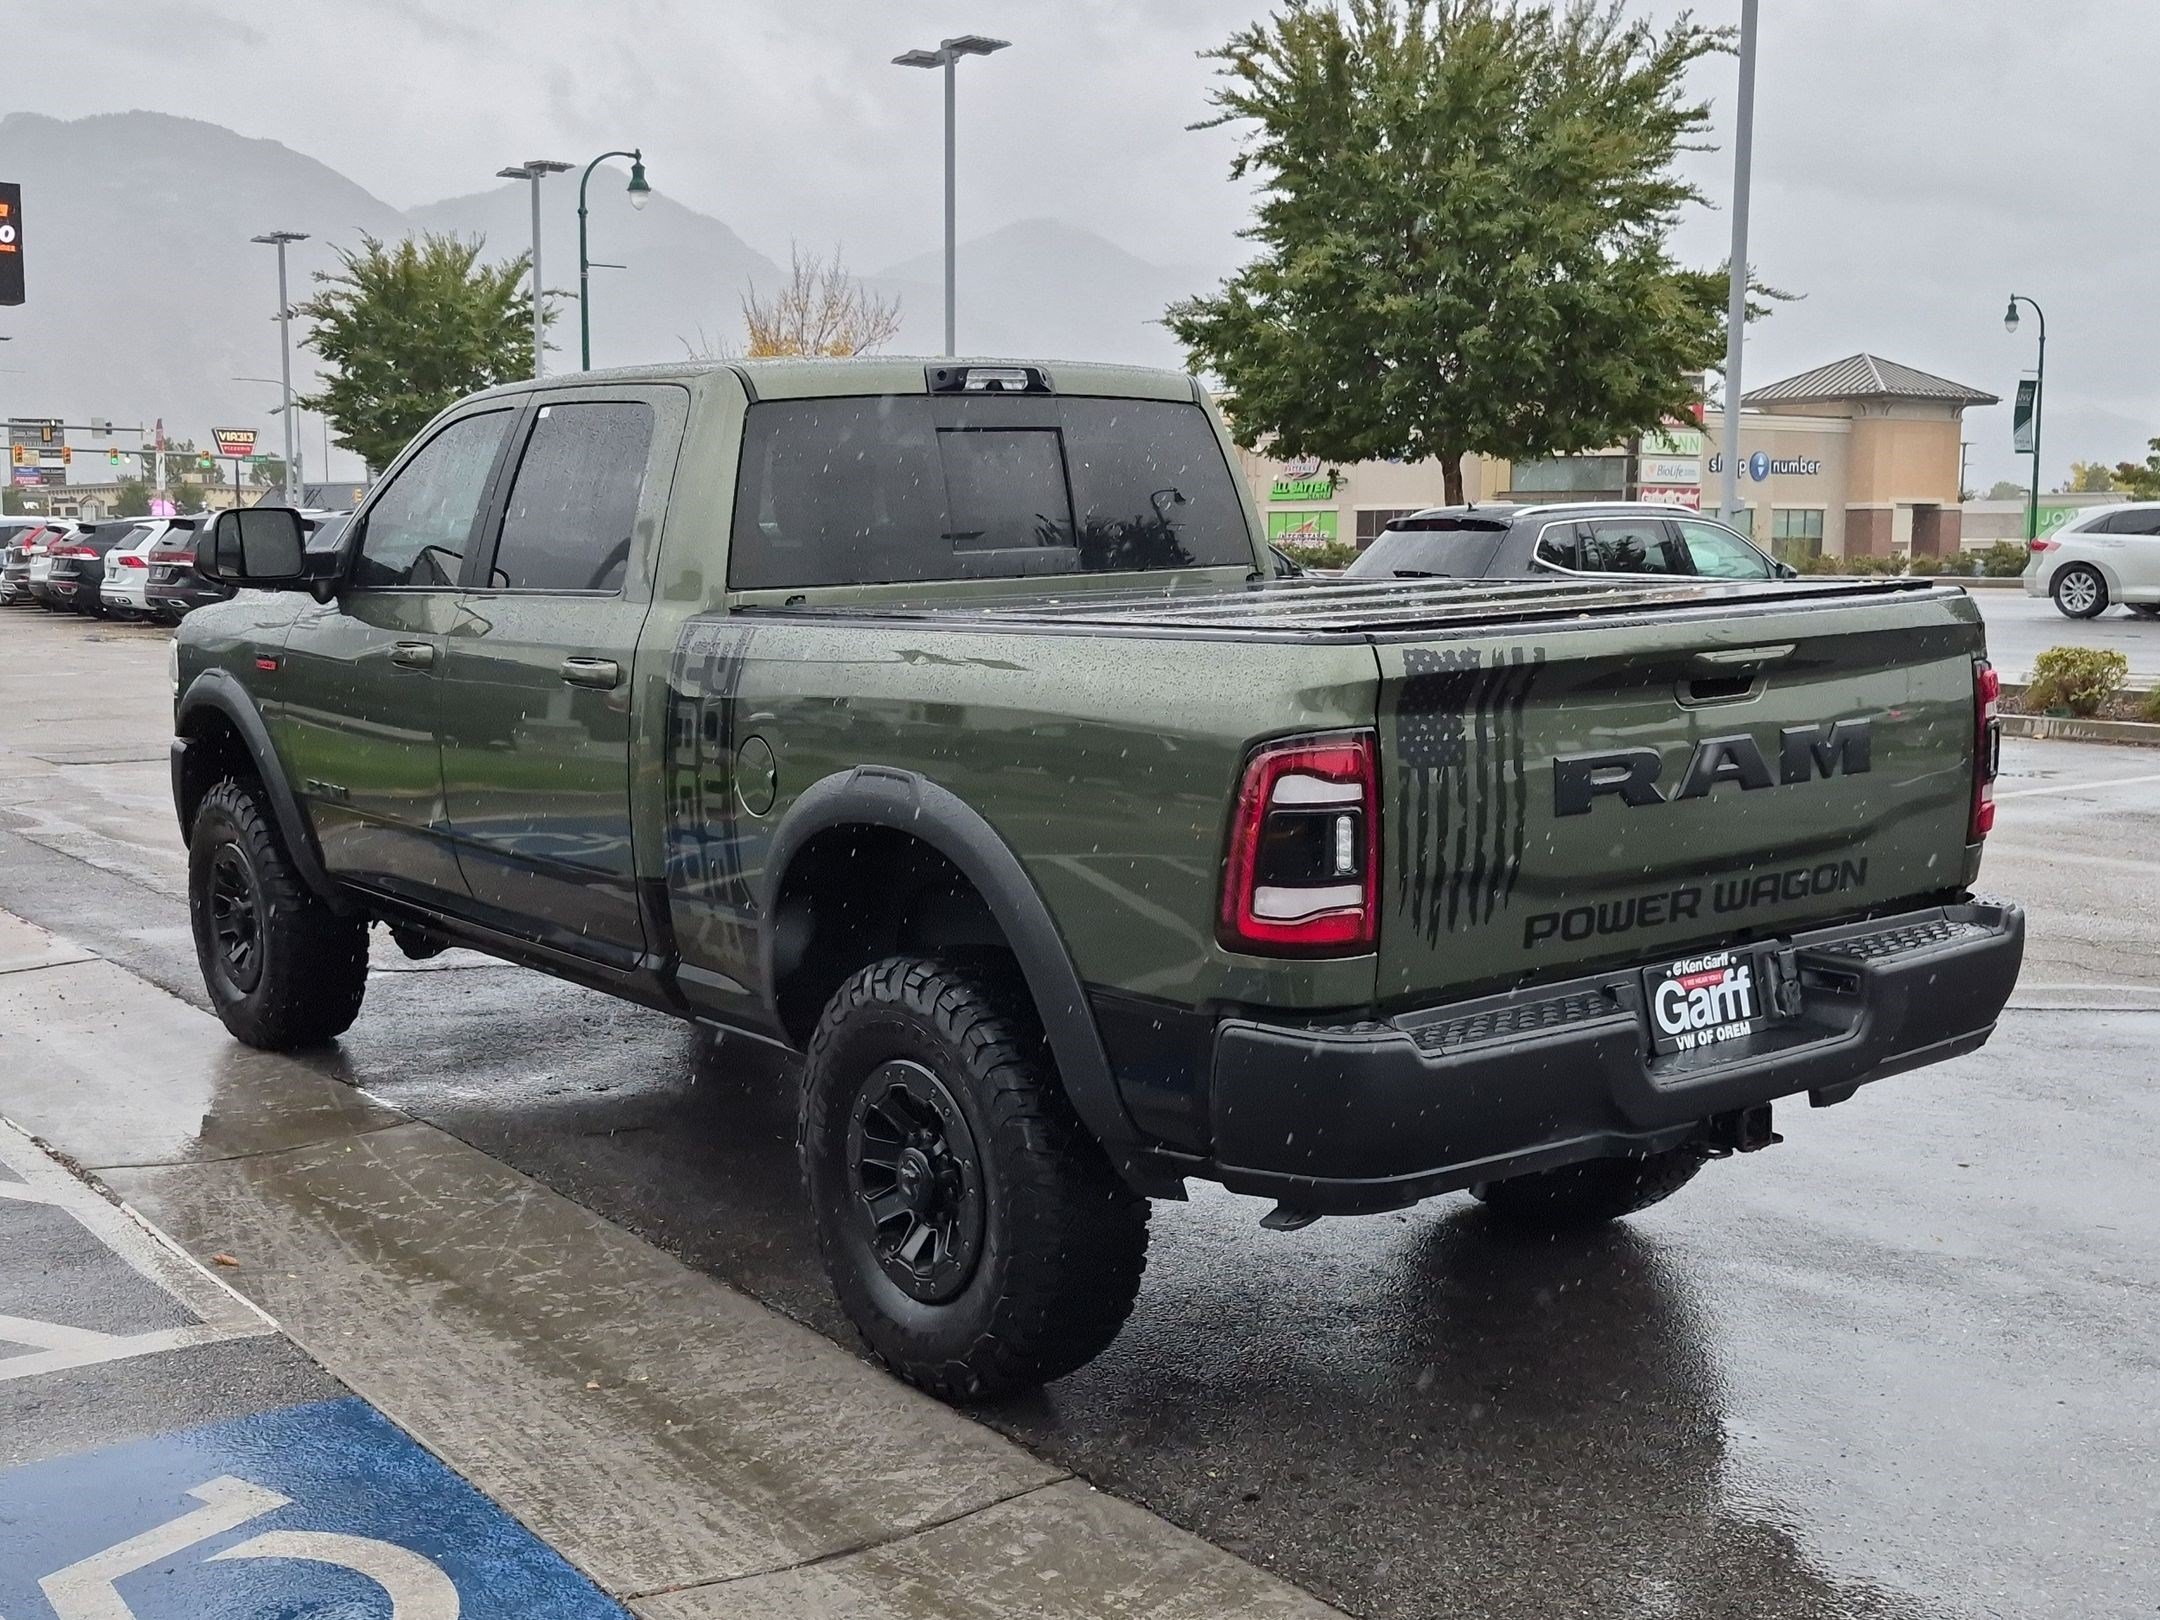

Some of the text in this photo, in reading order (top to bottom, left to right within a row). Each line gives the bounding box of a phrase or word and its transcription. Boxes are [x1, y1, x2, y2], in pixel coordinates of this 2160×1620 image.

[1656, 463, 1684, 479] BioLife
[1709, 453, 1821, 479] slp number
[1271, 482, 1290, 494] ALL
[1553, 717, 1872, 818] RAM
[1523, 857, 1868, 949] POWER WAGON
[1682, 952, 1729, 975] Ken Garff
[1687, 977, 1695, 986] WE
[1695, 975, 1709, 985] HEAR
[1655, 965, 1751, 1035] Garff
[1676, 1021, 1751, 1051] VW OF OREM
